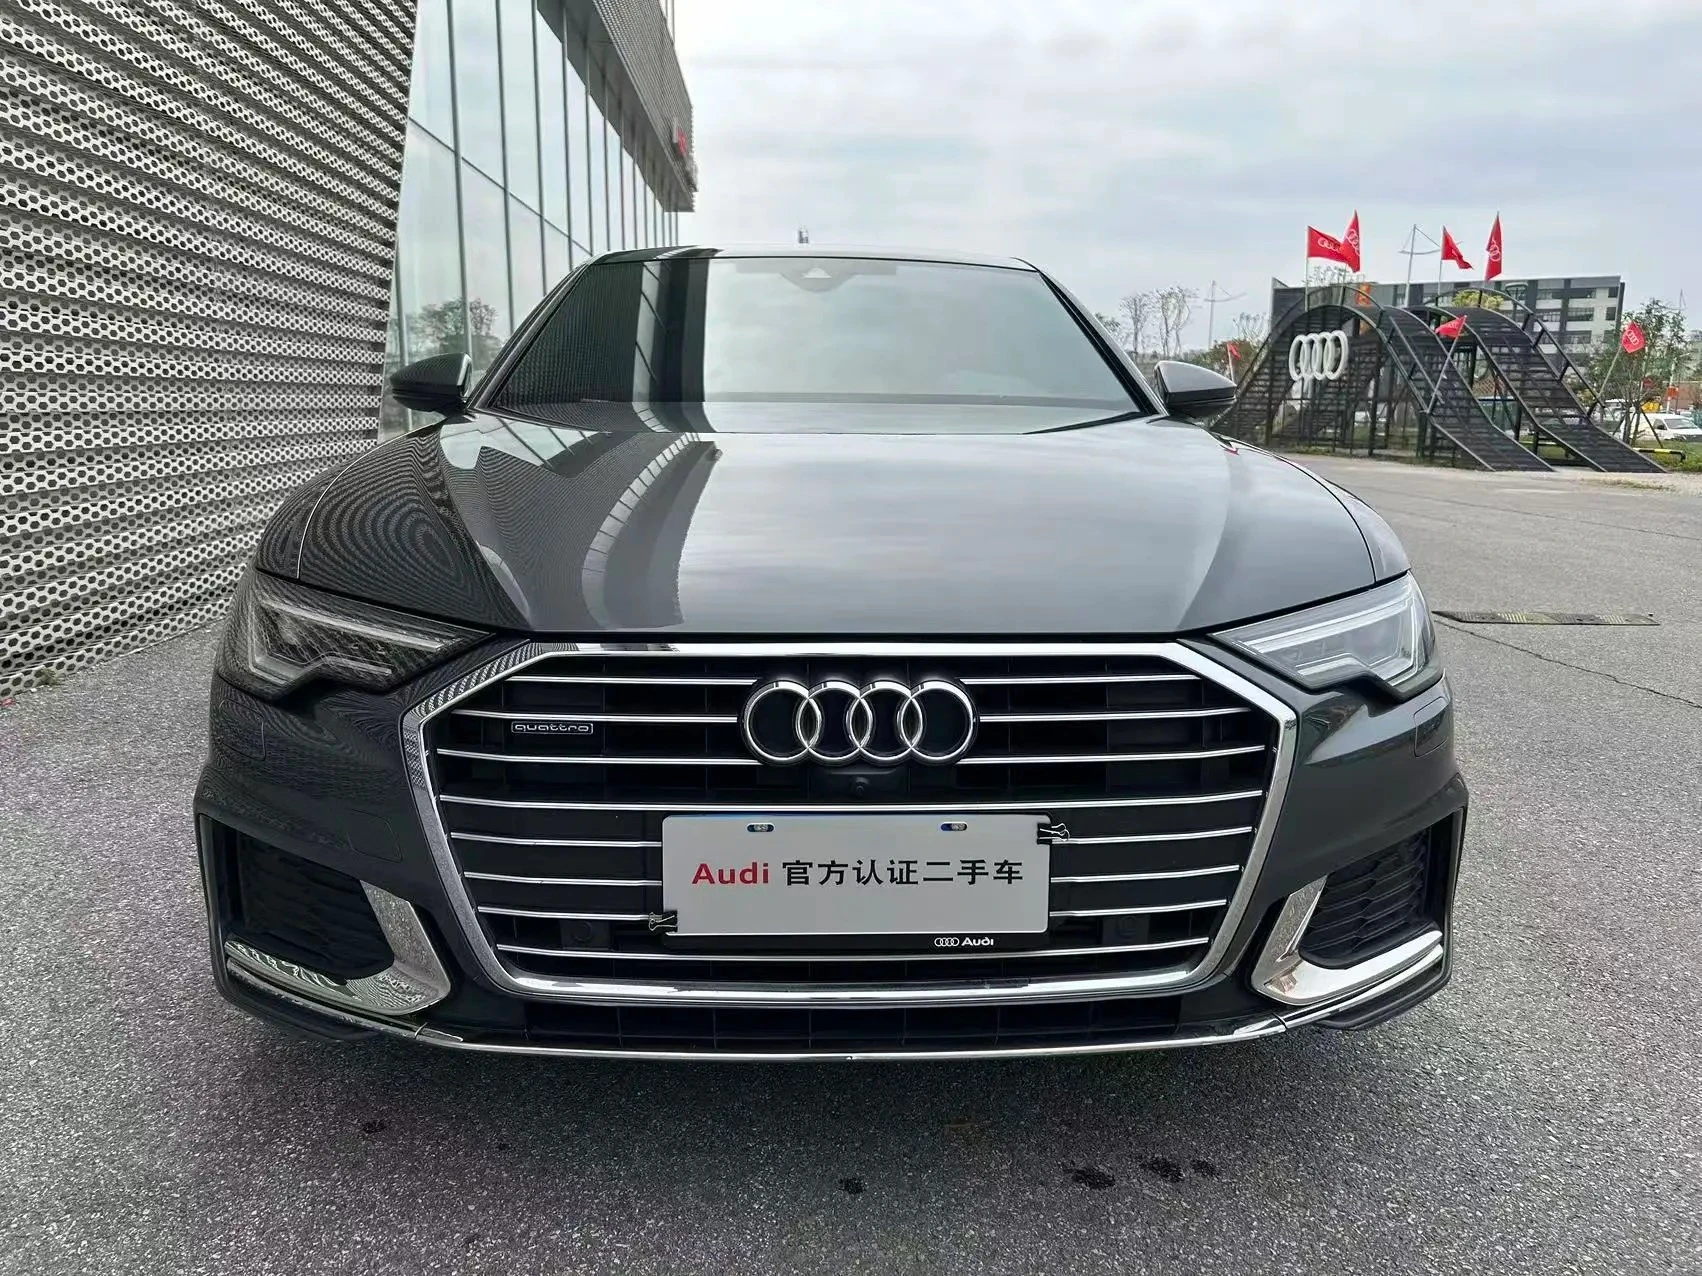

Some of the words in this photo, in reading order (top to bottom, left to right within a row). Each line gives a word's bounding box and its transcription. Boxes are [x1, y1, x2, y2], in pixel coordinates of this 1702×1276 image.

[691, 861, 770, 885] Audi
[782, 859, 1024, 886] 官方认证二手车
[961, 937, 994, 946] Audi
